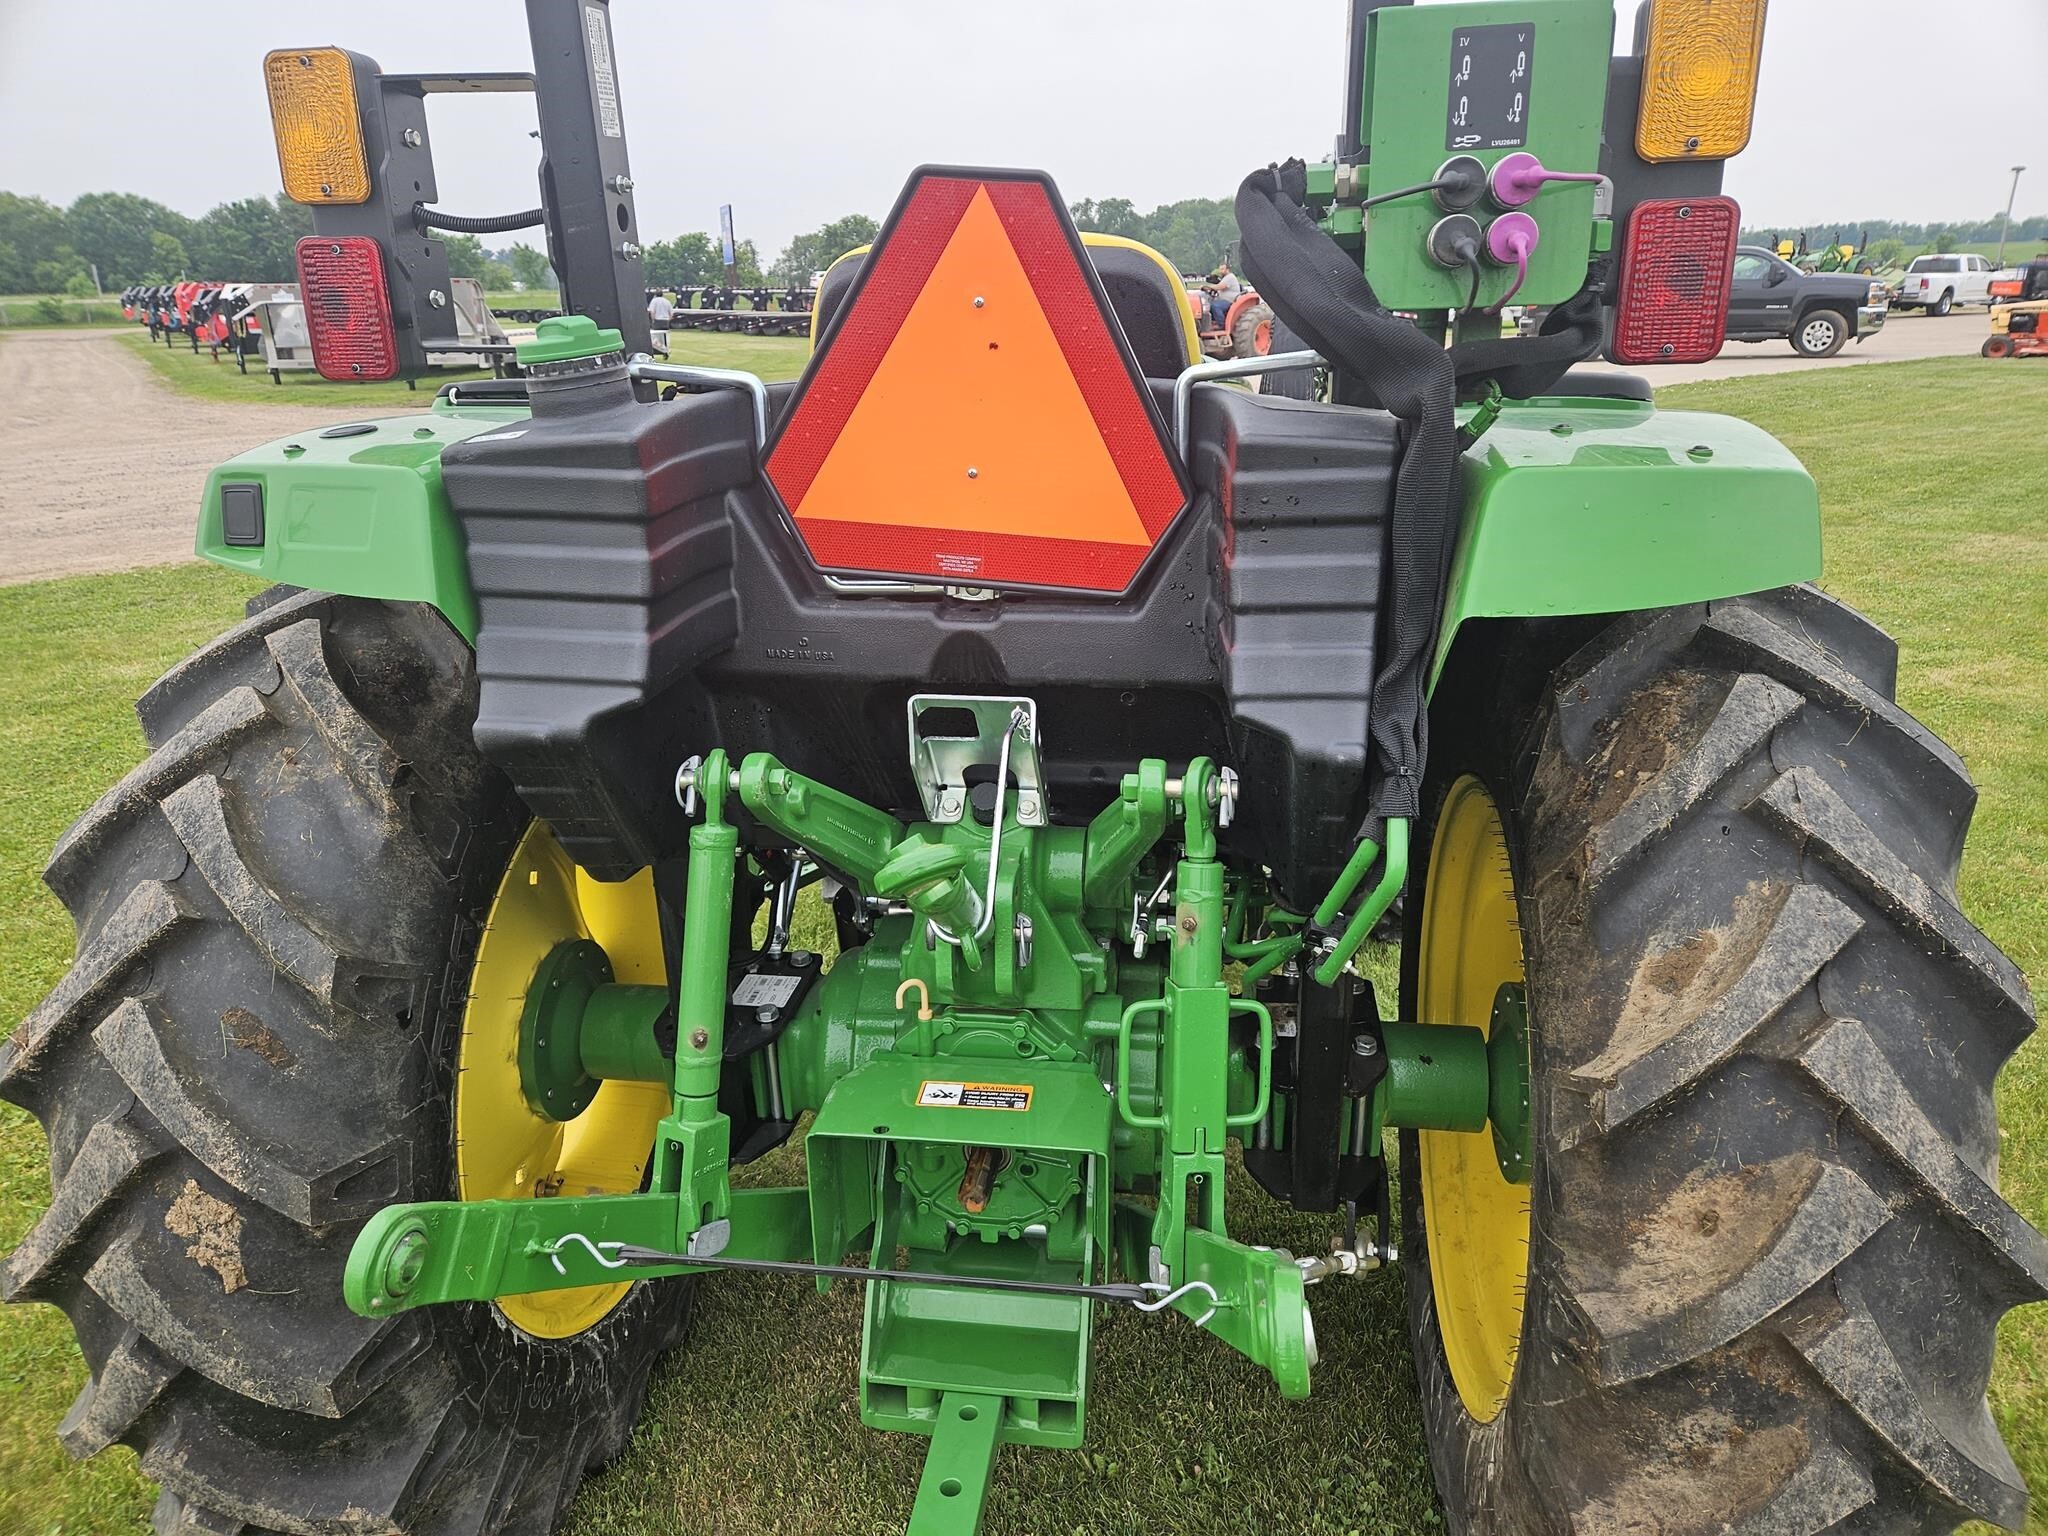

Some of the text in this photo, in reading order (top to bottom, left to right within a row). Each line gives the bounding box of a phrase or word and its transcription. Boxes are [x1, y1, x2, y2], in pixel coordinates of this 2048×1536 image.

[1459, 37, 1470, 46] IV
[1518, 33, 1525, 42] V
[767, 648, 834, 661] MADE IN USA
